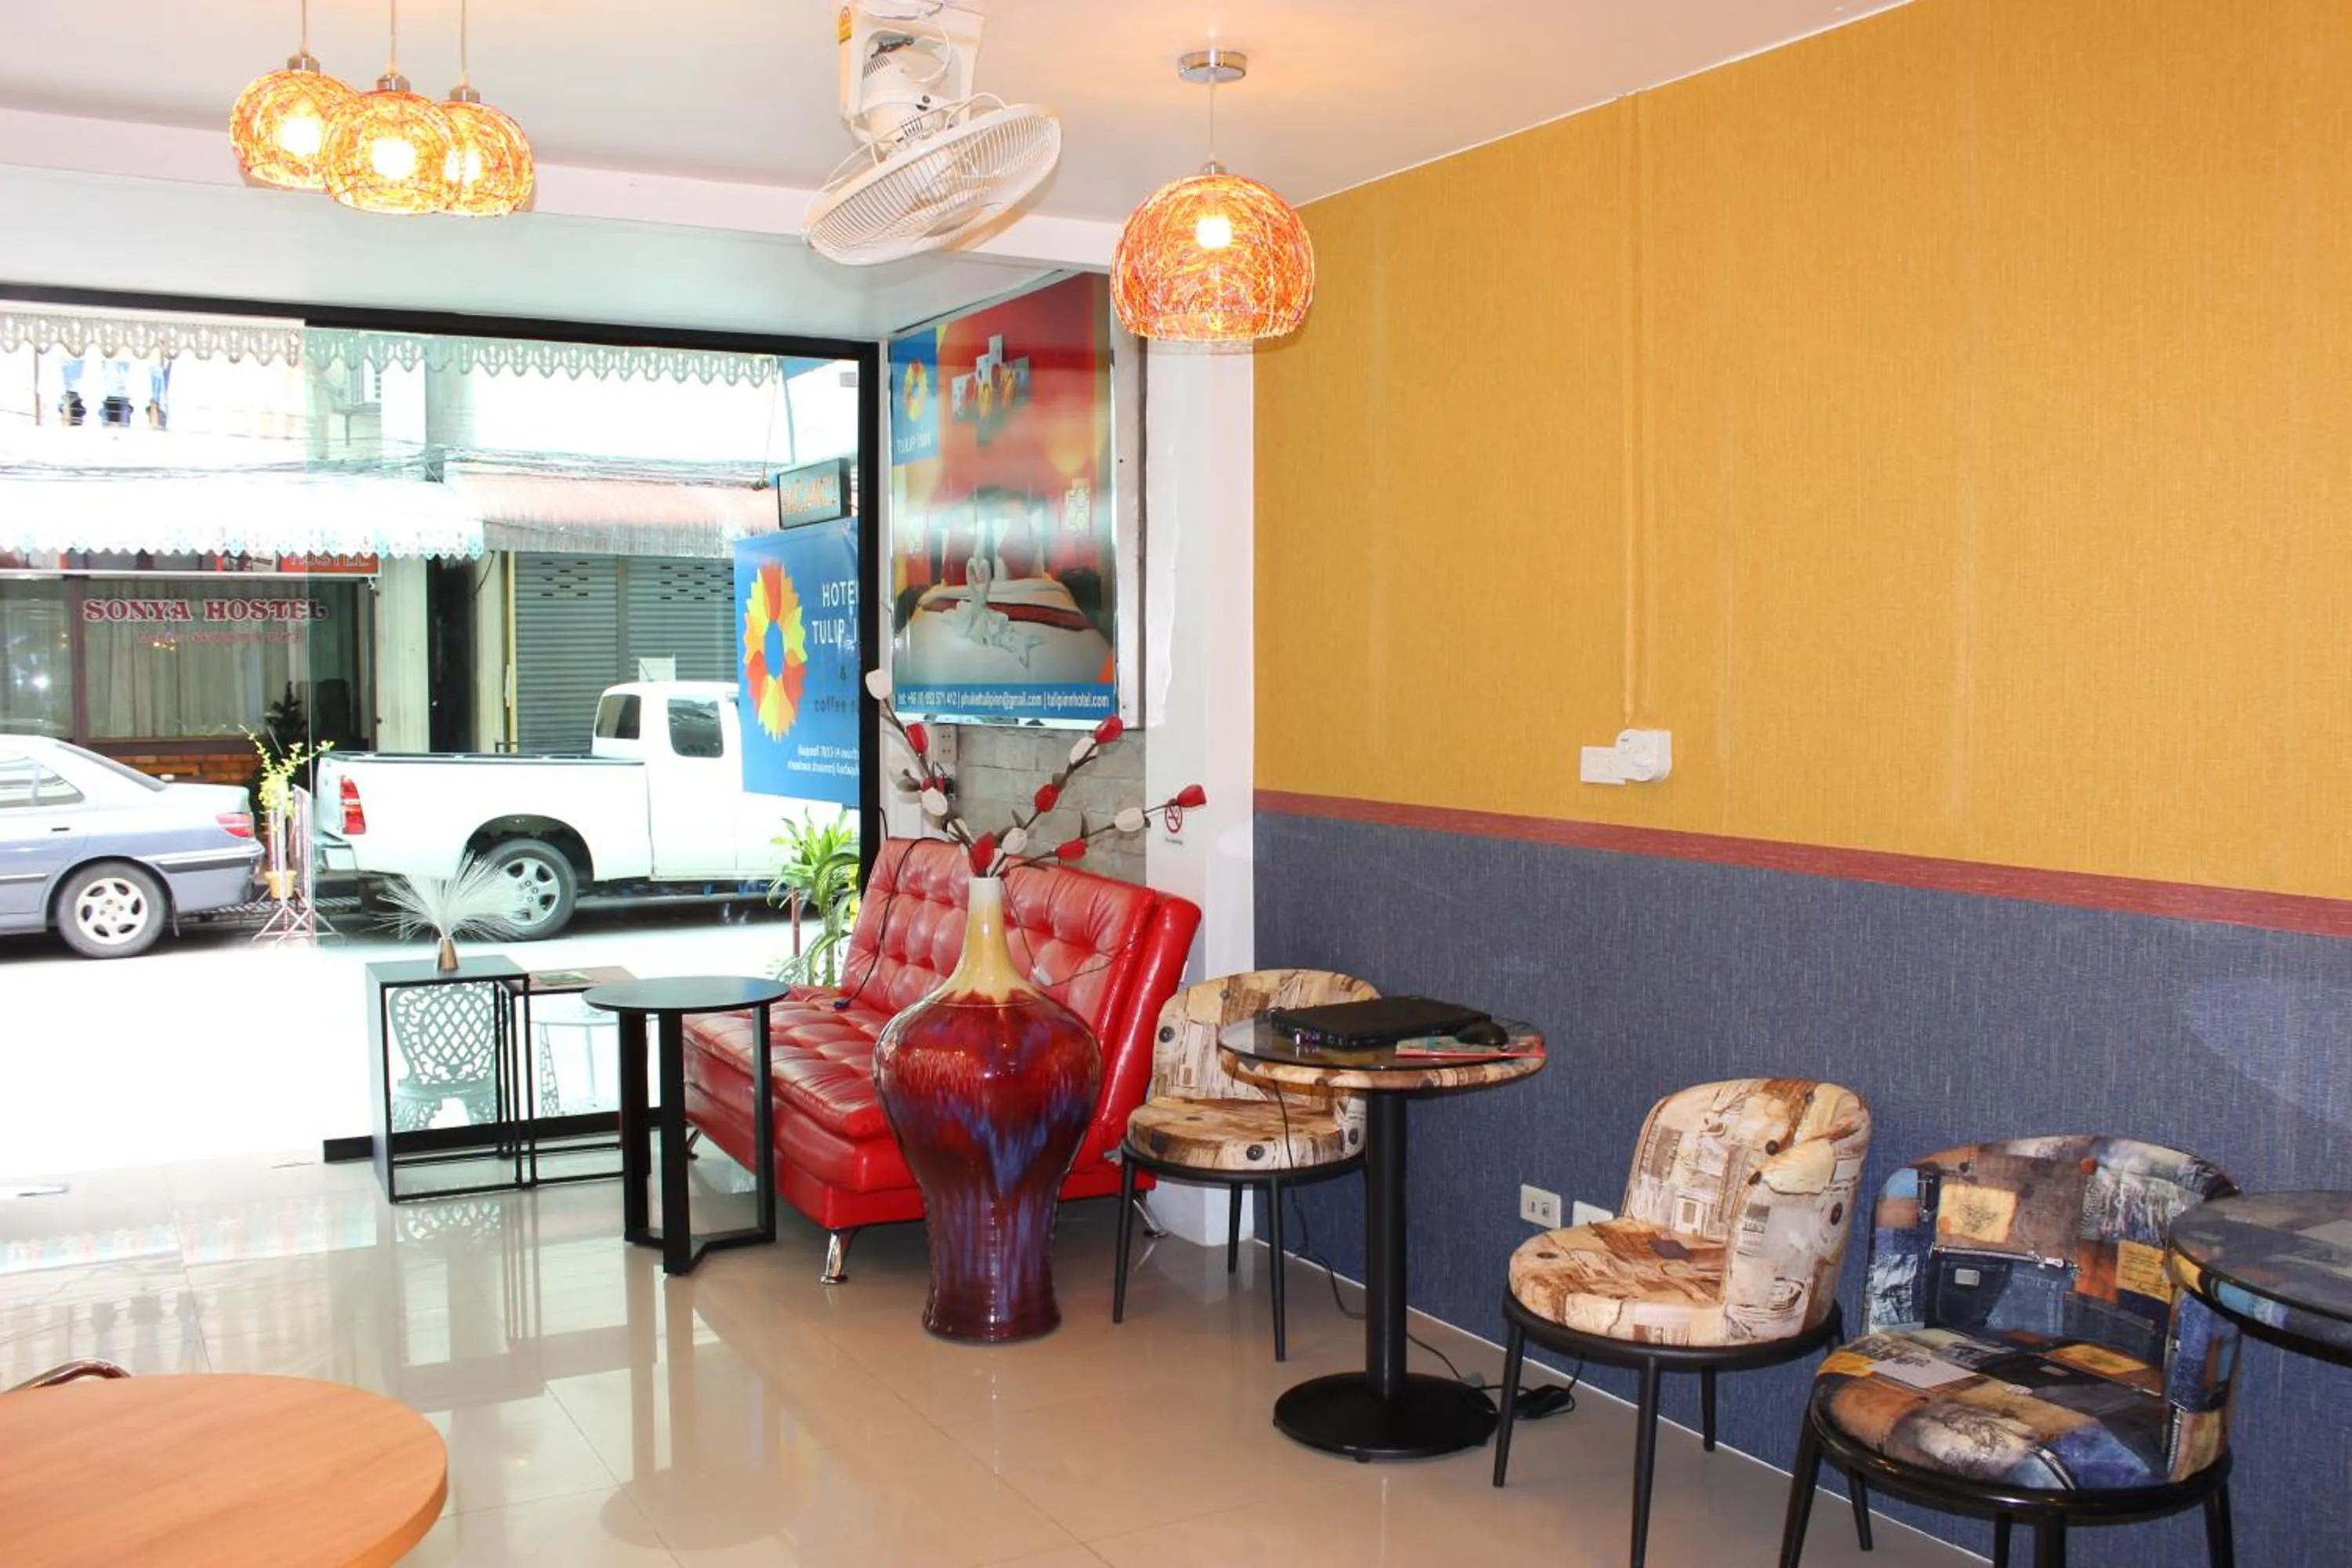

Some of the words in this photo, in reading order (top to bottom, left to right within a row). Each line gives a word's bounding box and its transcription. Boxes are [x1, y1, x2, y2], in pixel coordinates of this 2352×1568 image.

[83, 598, 192, 622] SONYA
[203, 598, 328, 622] HOSTEL
[811, 619, 844, 645] TULIP
